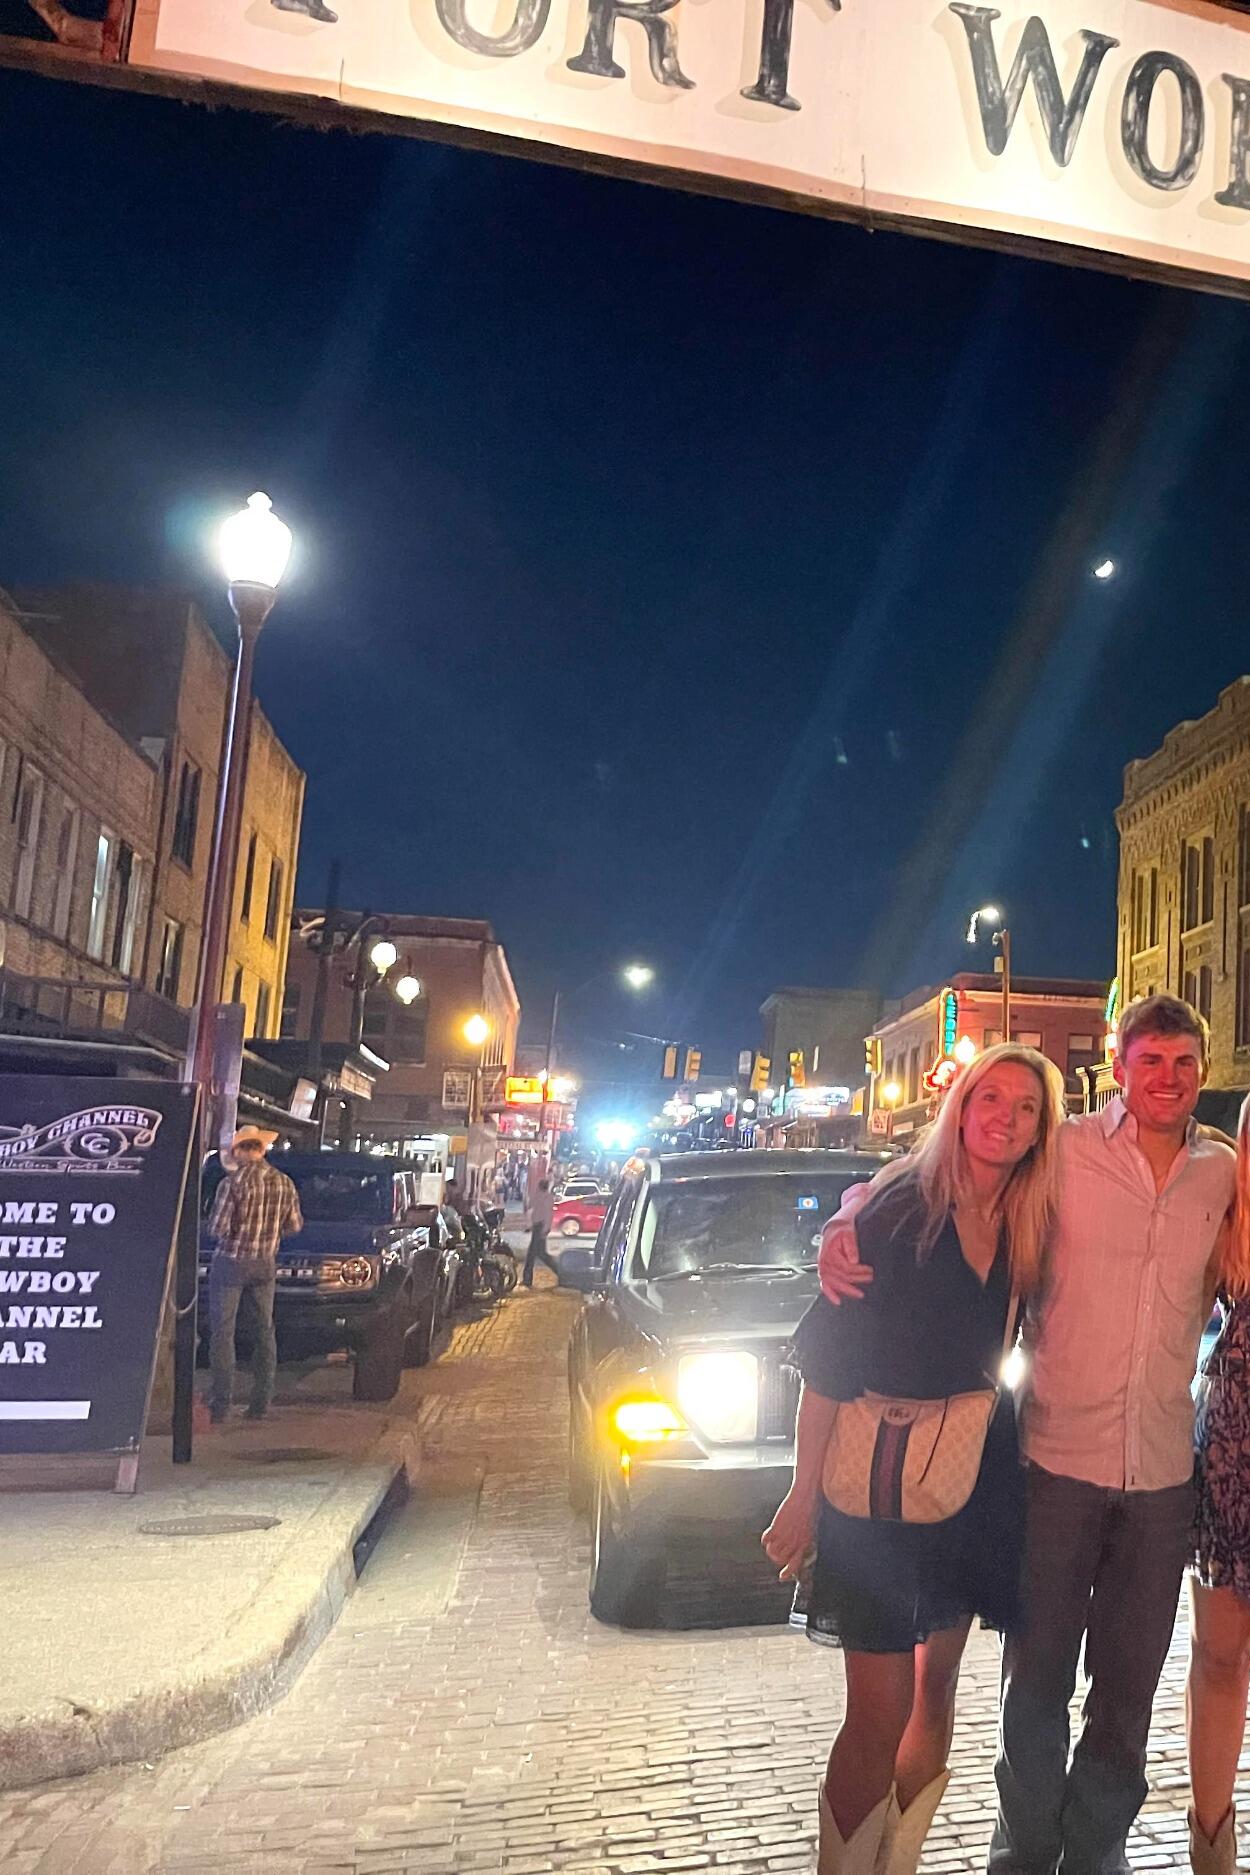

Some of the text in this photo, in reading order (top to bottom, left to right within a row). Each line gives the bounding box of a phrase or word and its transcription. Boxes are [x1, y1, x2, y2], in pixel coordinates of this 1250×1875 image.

[48, 1110, 149, 1140] CHANNEL
[0, 1202, 116, 1224] ME TO
[0, 1236, 67, 1258] THE
[0, 1306, 103, 1328] NNEL
